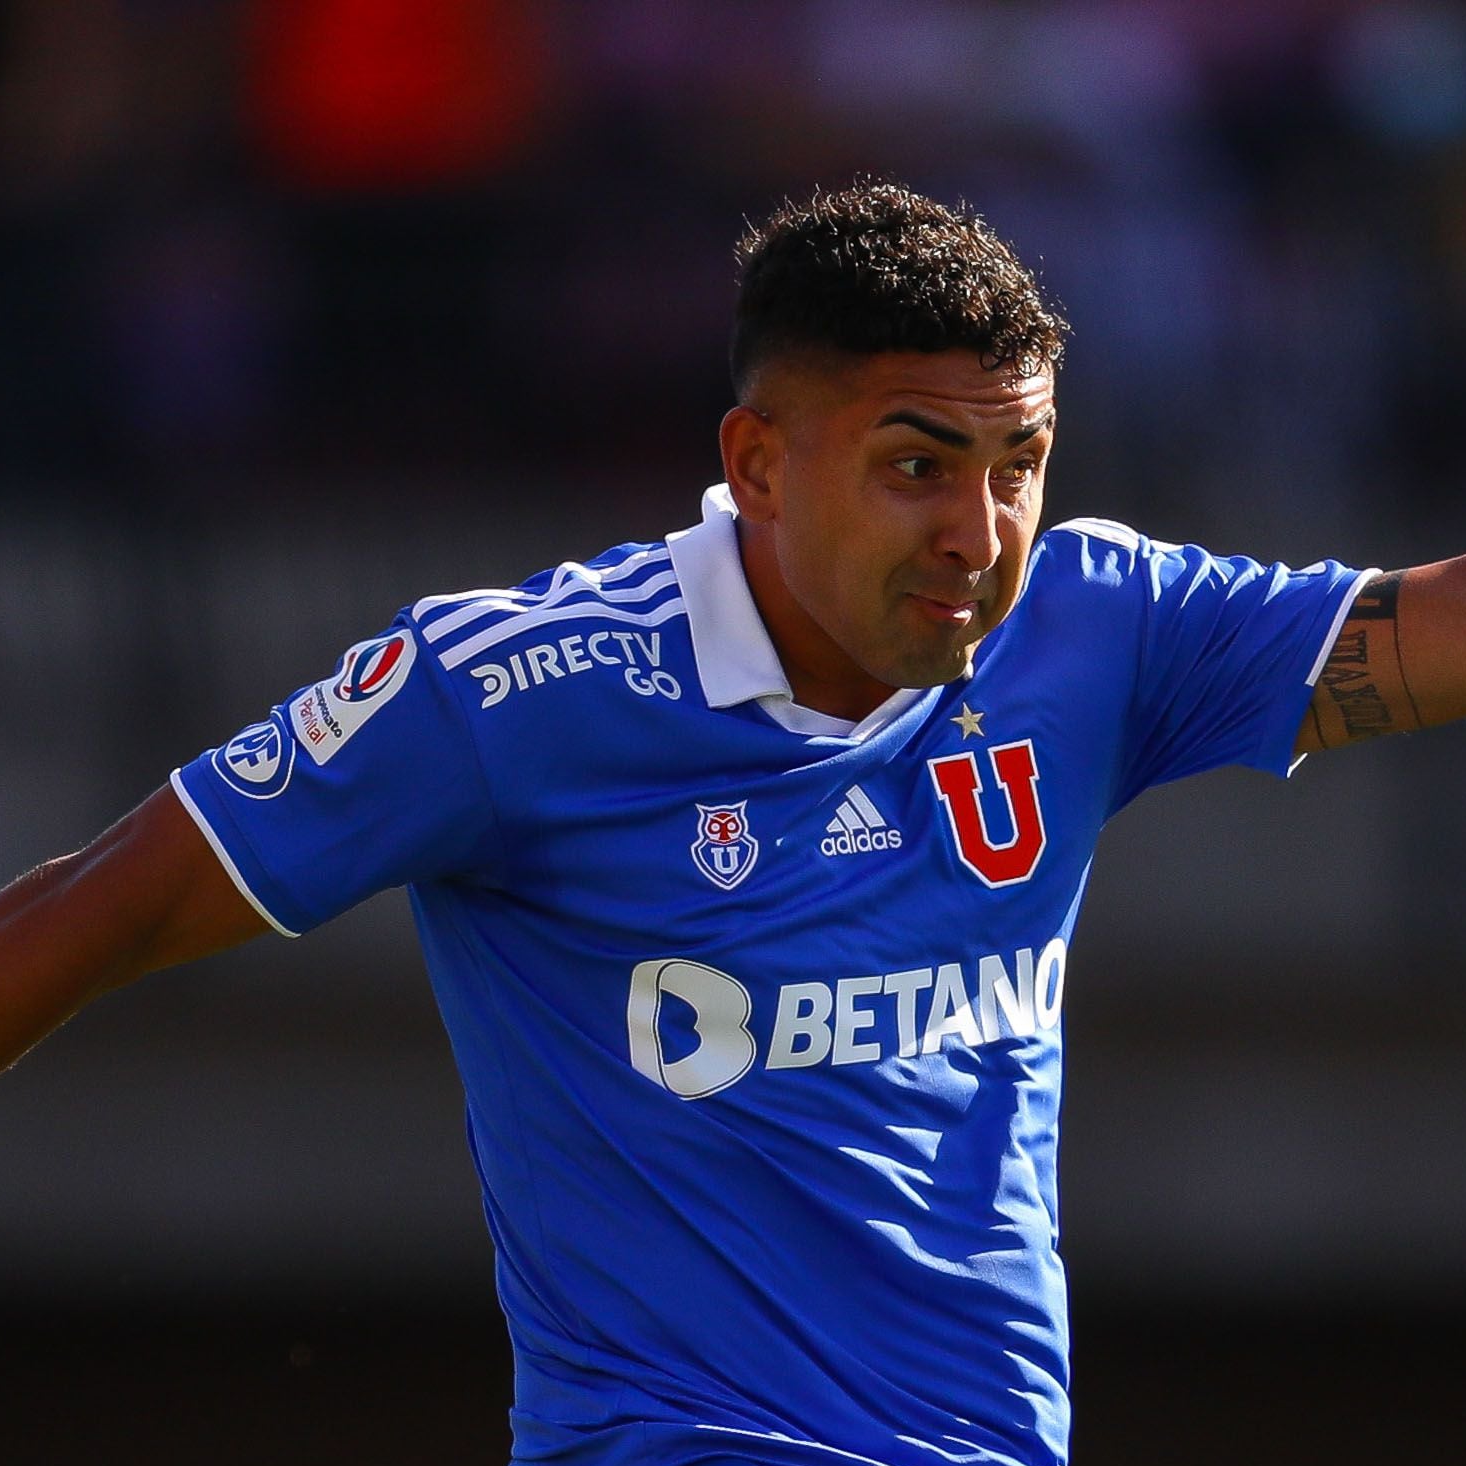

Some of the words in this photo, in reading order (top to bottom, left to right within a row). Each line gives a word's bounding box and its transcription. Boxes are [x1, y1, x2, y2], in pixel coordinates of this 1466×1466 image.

[470, 631, 660, 709] DIRECTV
[625, 667, 682, 700] GO
[927, 739, 1046, 889] U
[711, 846, 739, 874] U
[821, 828, 902, 856] adidas
[765, 938, 1068, 1071] BETANO
